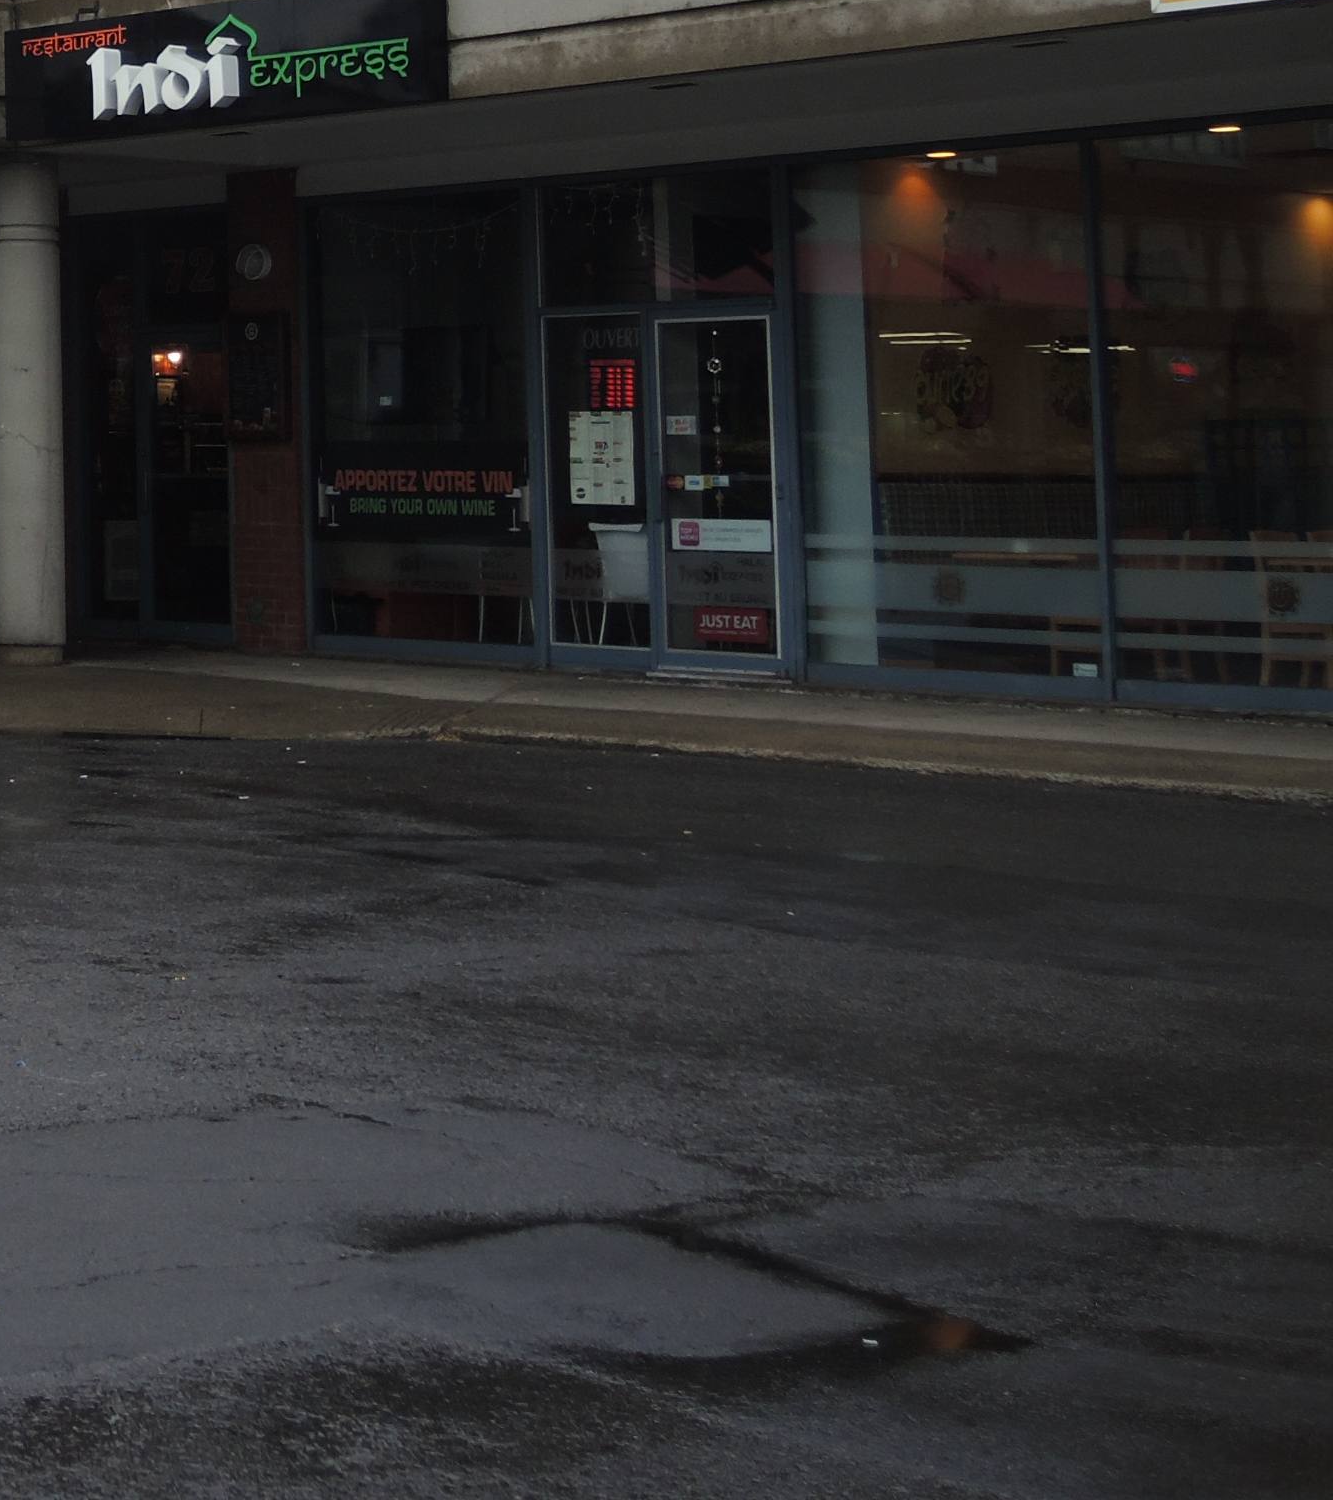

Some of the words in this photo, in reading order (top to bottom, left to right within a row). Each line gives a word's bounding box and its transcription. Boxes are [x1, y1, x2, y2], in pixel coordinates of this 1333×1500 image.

[21, 23, 128, 58] restaurant
[248, 37, 409, 98] express
[160, 247, 216, 294] 72
[582, 326, 640, 351] OUVERT
[334, 469, 418, 492] APPORTEZ
[422, 470, 477, 493] VOTRE
[481, 470, 514, 494] VIN
[349, 497, 387, 514] BRING
[390, 497, 423, 515] YOUR
[426, 498, 458, 516] OWN
[461, 498, 496, 517] WINE
[698, 613, 732, 629] JUST
[732, 614, 758, 630] EAT
